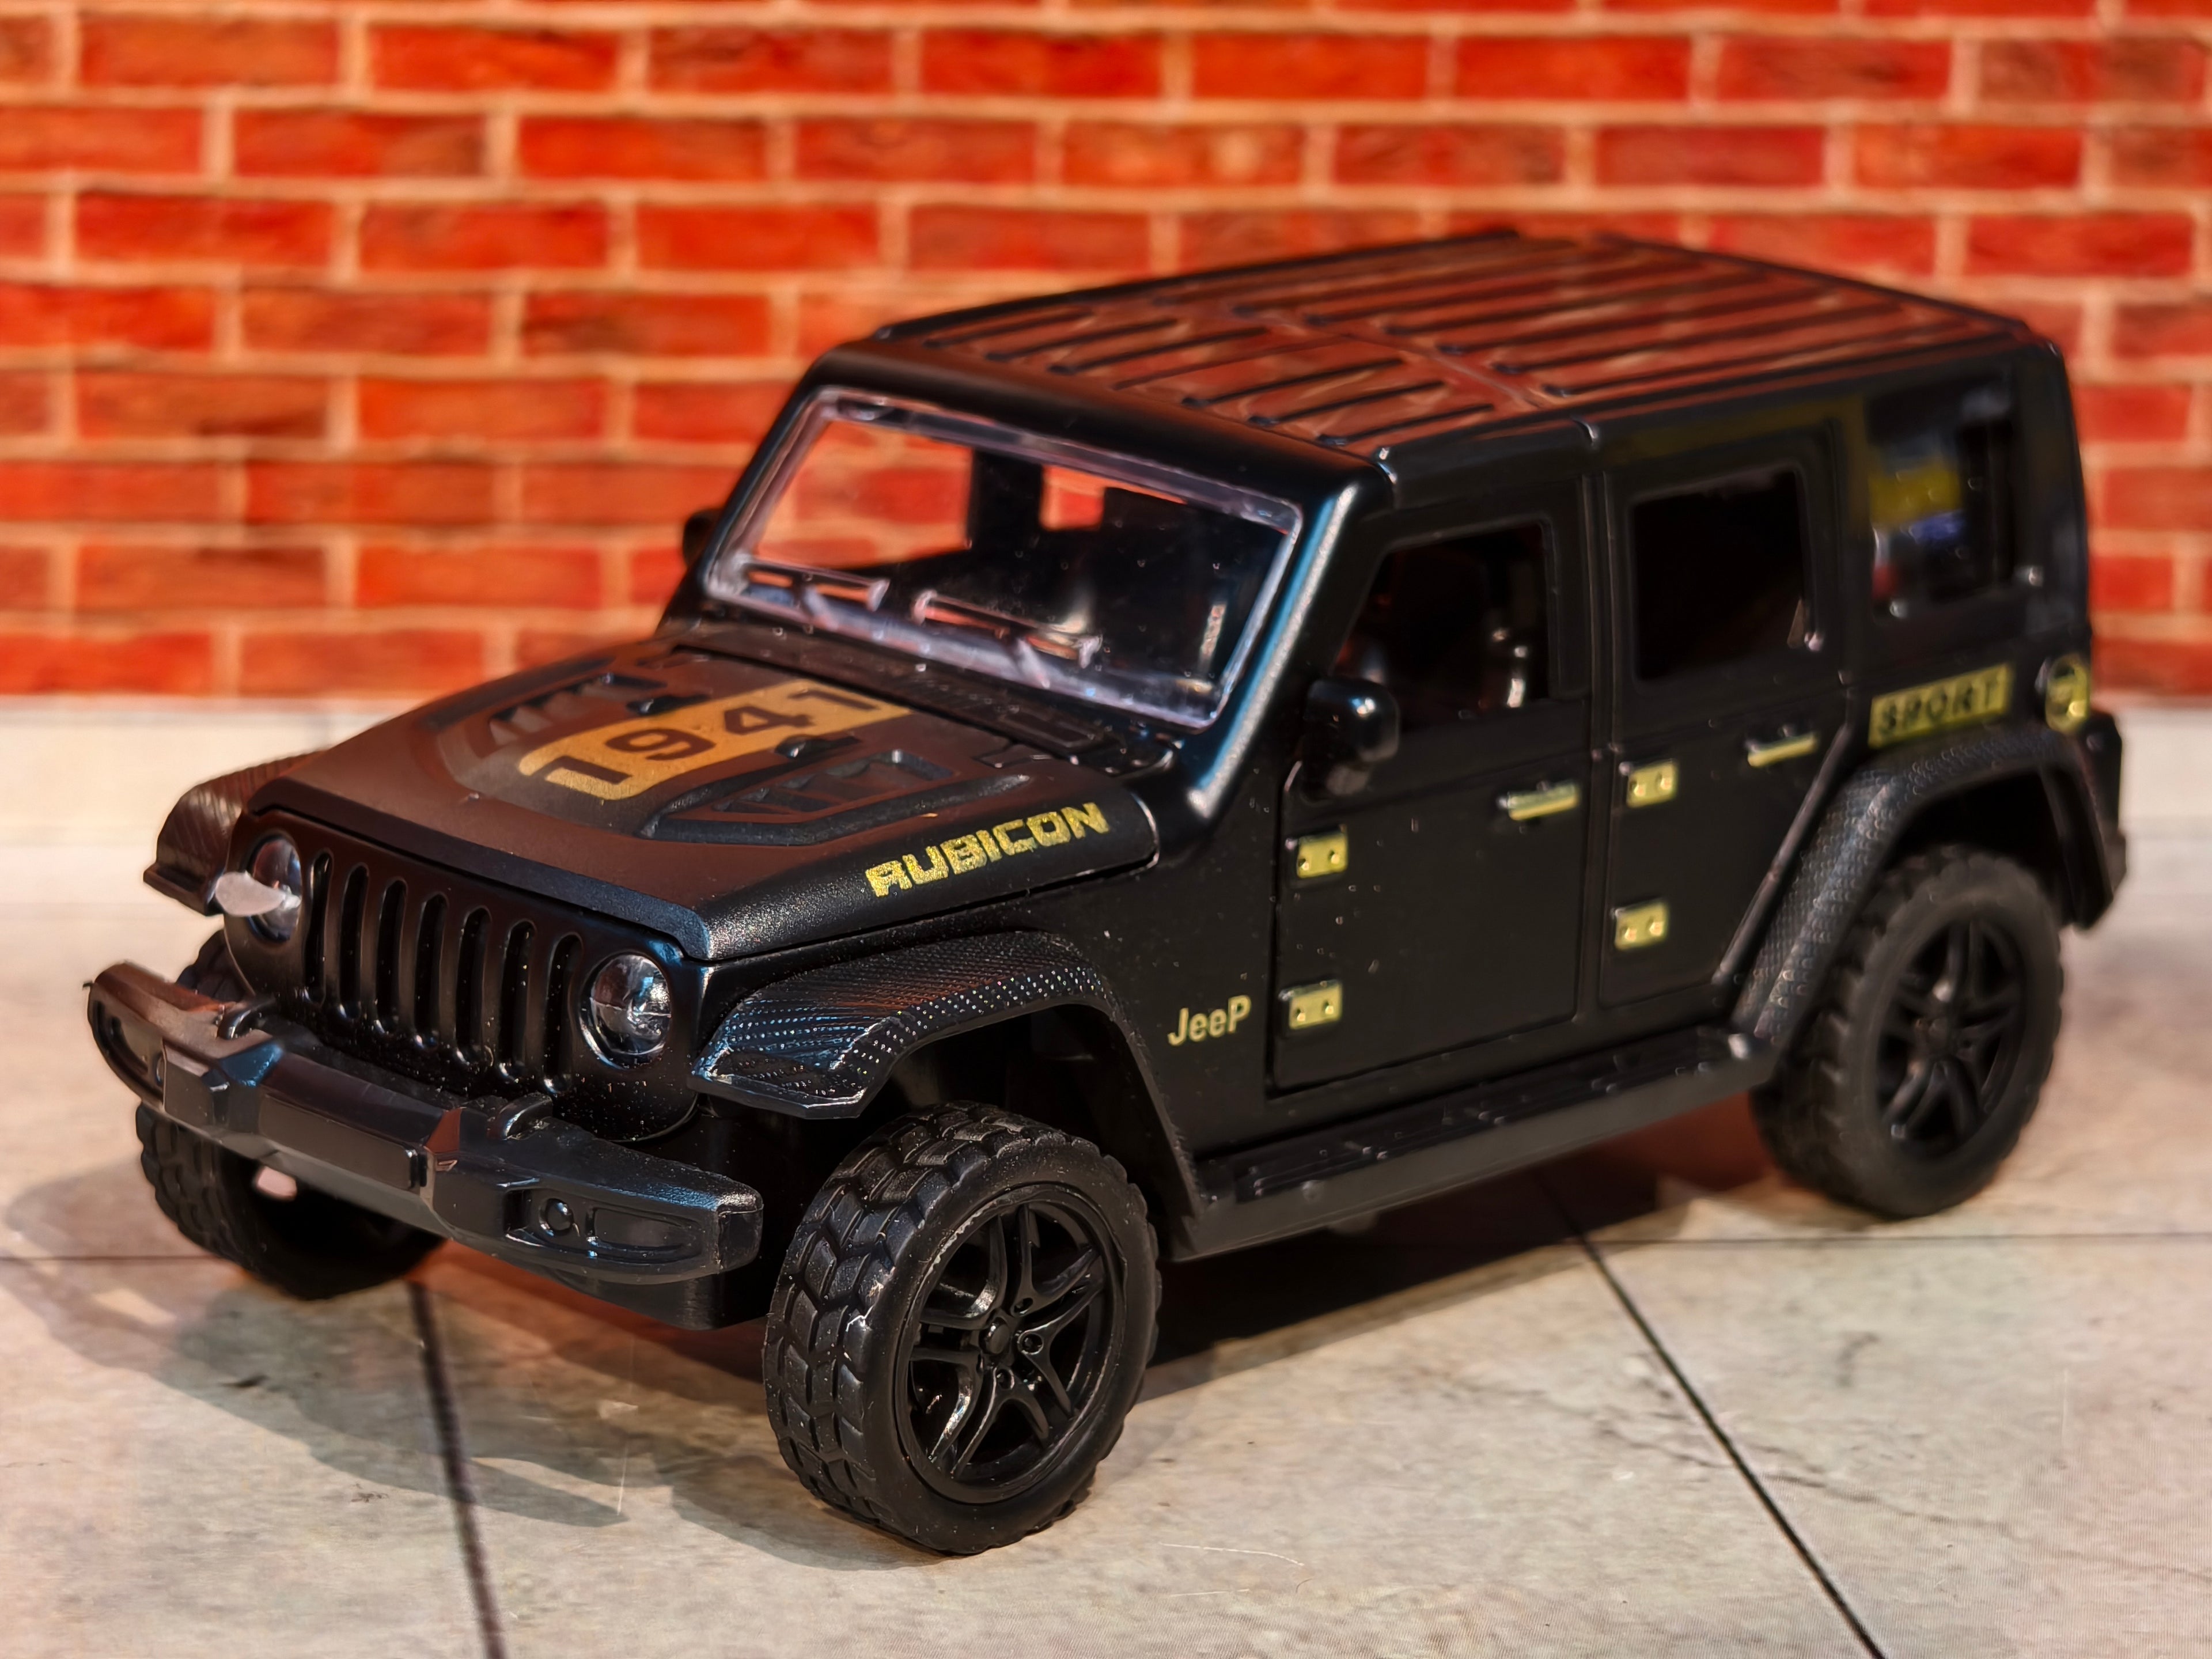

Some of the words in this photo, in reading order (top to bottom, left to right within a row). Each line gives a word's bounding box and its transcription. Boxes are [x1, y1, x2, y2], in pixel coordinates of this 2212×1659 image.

[531, 688, 878, 785] 1941
[1875, 669, 2006, 741] SPORT
[865, 802, 1110, 897] RUBICON
